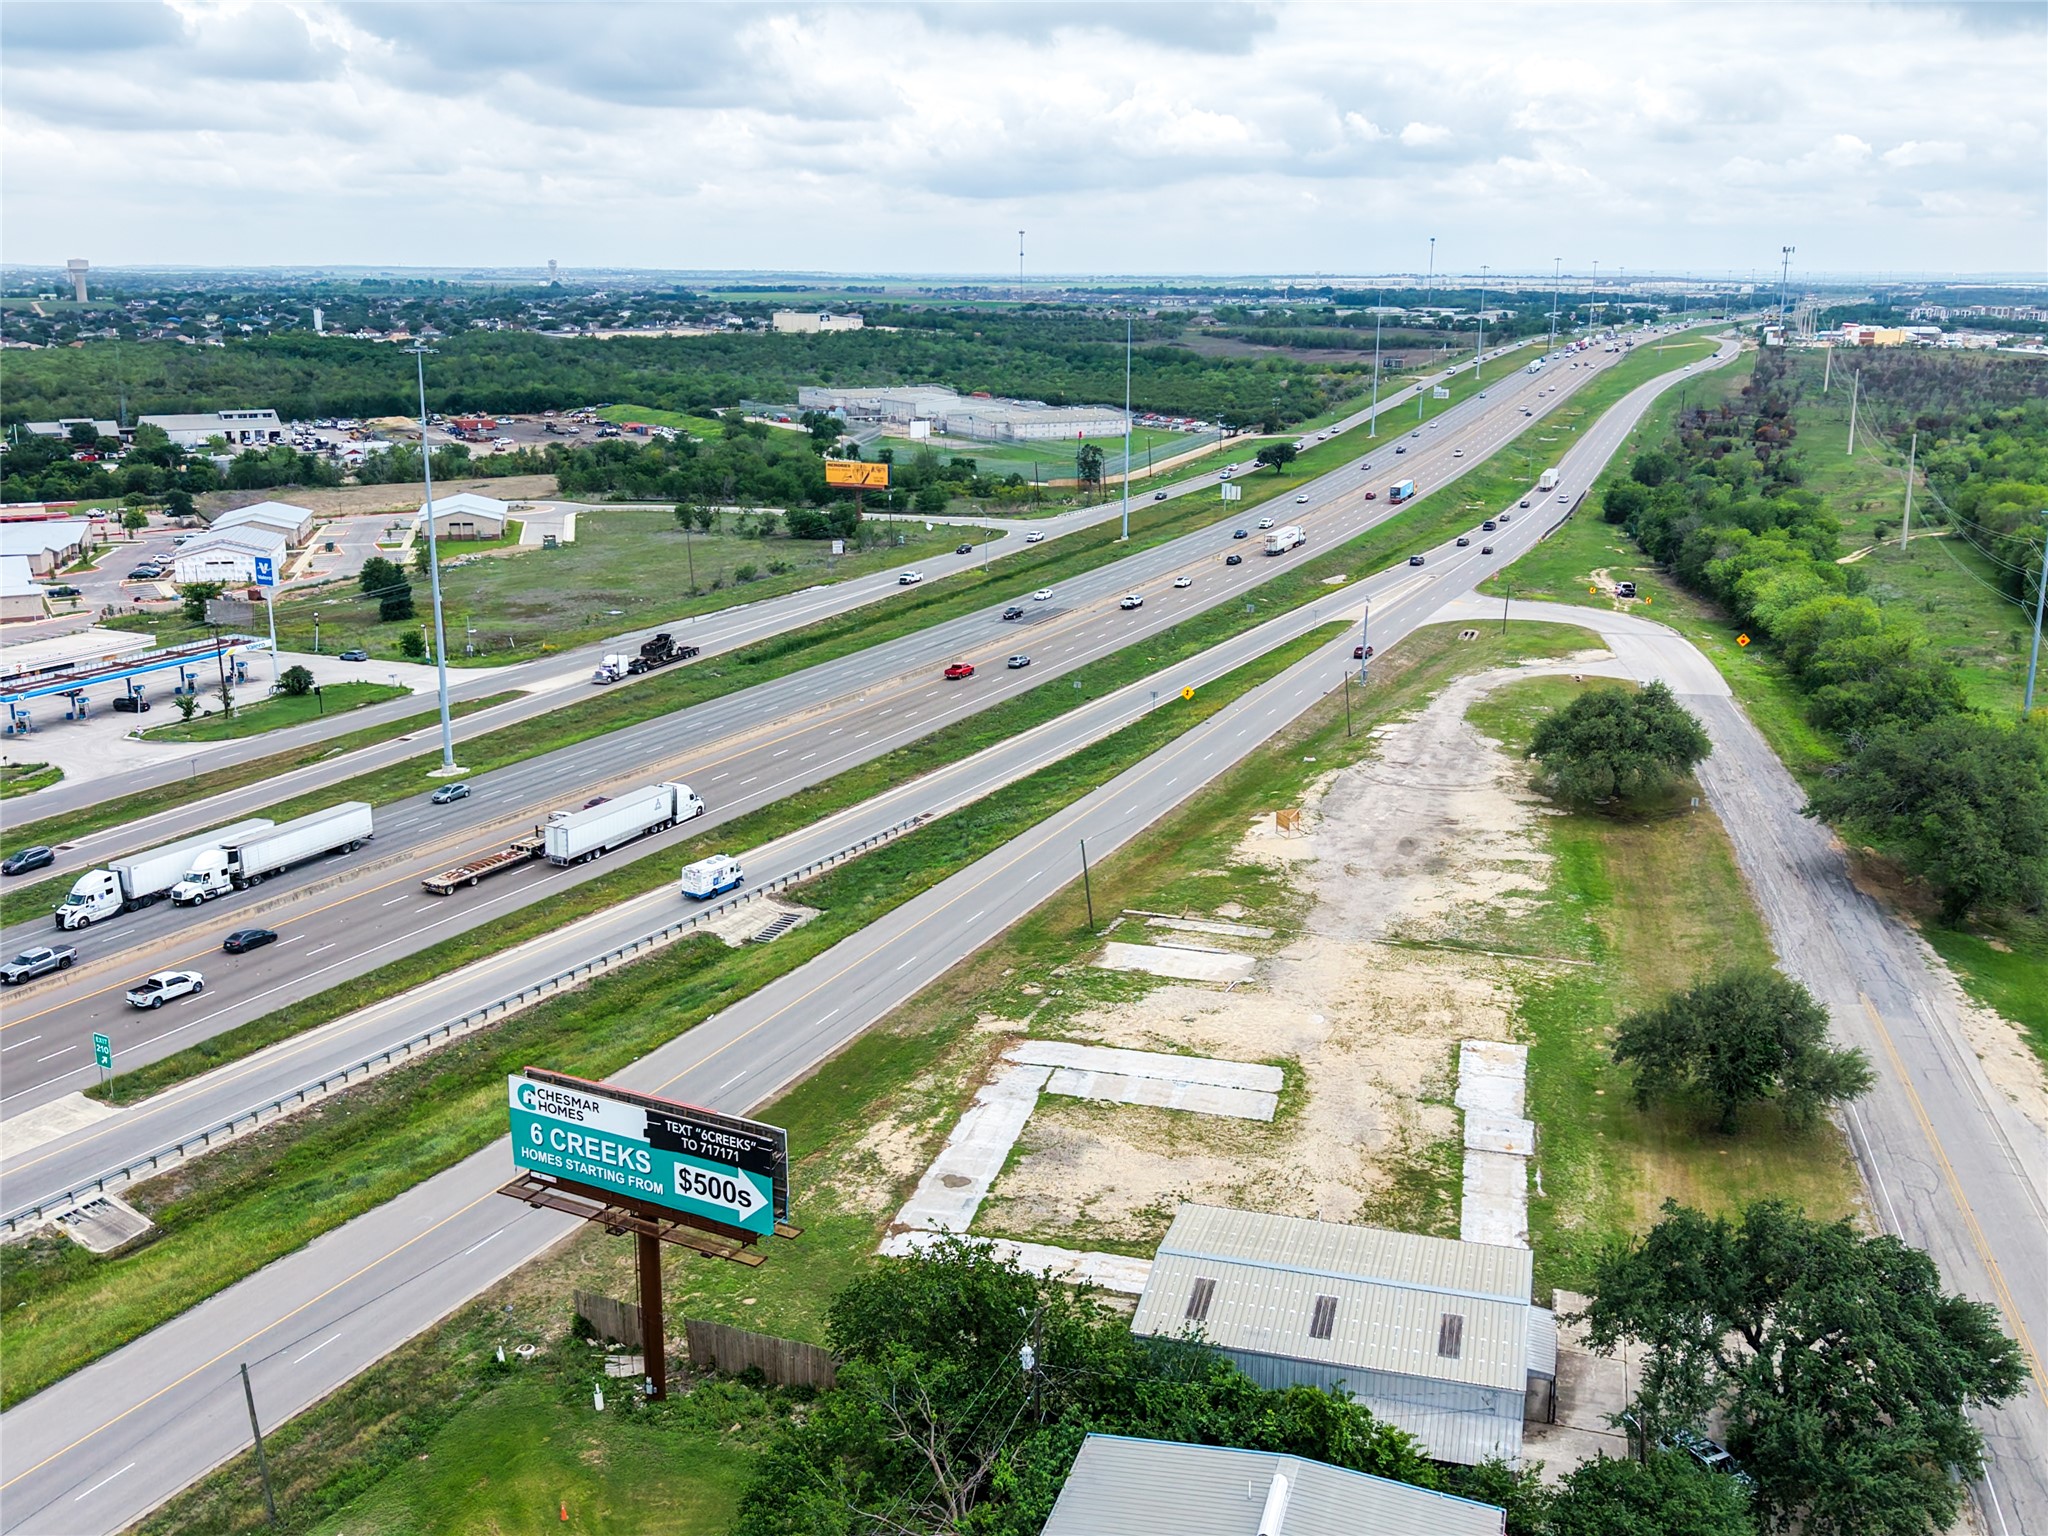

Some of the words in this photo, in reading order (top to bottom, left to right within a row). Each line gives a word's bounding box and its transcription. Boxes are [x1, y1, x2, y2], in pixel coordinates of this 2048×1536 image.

[245, 642, 266, 650] Valero
[95, 1036, 107, 1044] EXIT
[96, 1044, 109, 1054] 210
[537, 1088, 600, 1114] CHESMAR
[538, 1099, 584, 1122] HOMES
[664, 1119, 693, 1137] TEXT
[530, 1122, 544, 1145] 6
[549, 1127, 652, 1174] CREEKS
[682, 1136, 698, 1152] TO
[699, 1141, 740, 1163] 717171
[521, 1146, 563, 1168] HOMES
[565, 1156, 626, 1185] STARTING
[628, 1175, 664, 1196] FROM
[678, 1166, 752, 1208] $500s
